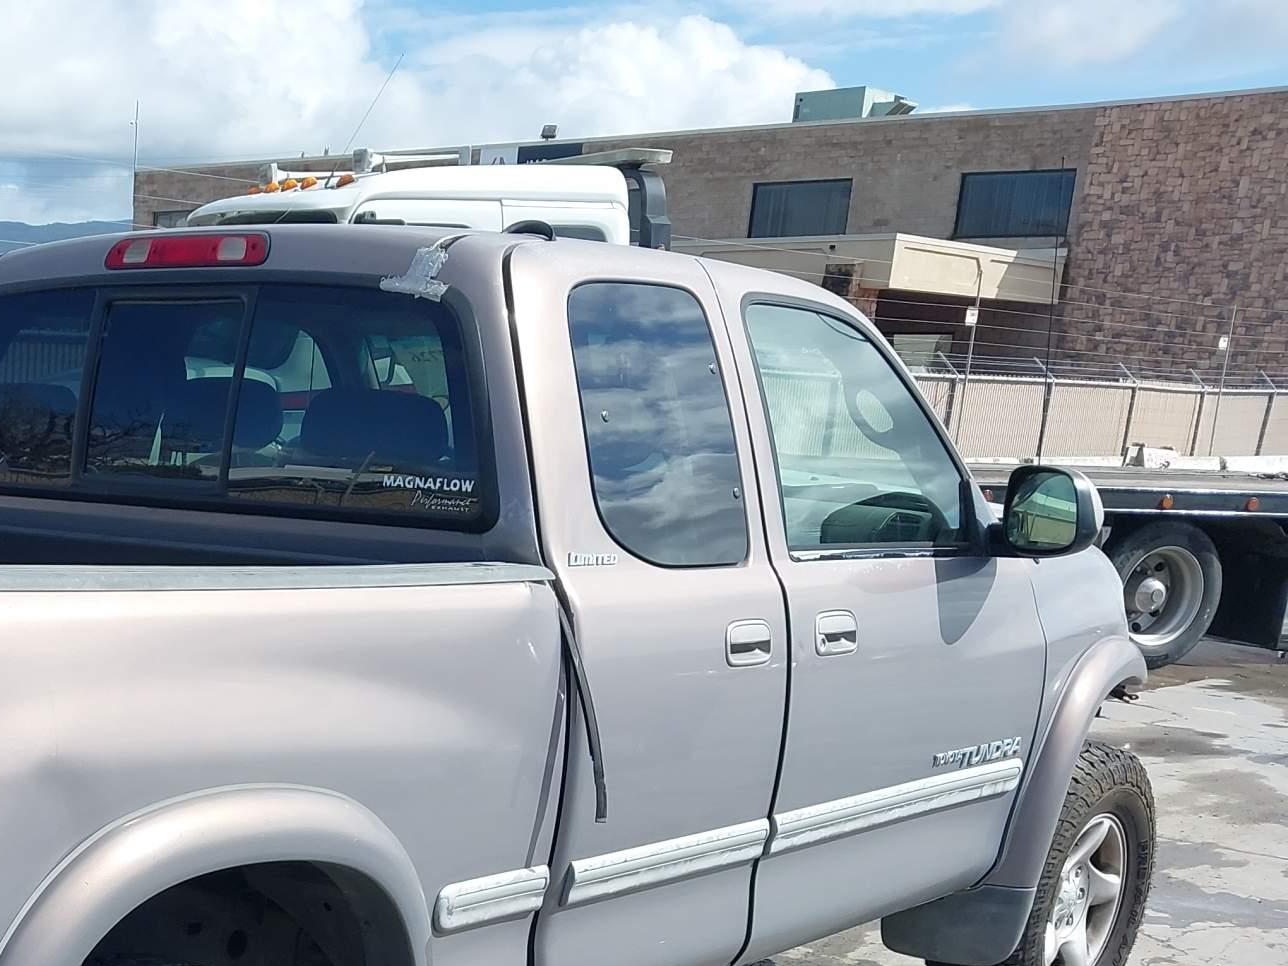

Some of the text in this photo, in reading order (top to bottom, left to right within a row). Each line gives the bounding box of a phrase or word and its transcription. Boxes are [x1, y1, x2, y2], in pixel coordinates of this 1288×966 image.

[382, 475, 475, 492] MAGNAFLOW
[410, 490, 479, 509] Performance
[567, 552, 618, 567] LIMITED
[958, 736, 1023, 769] TUNDRA
